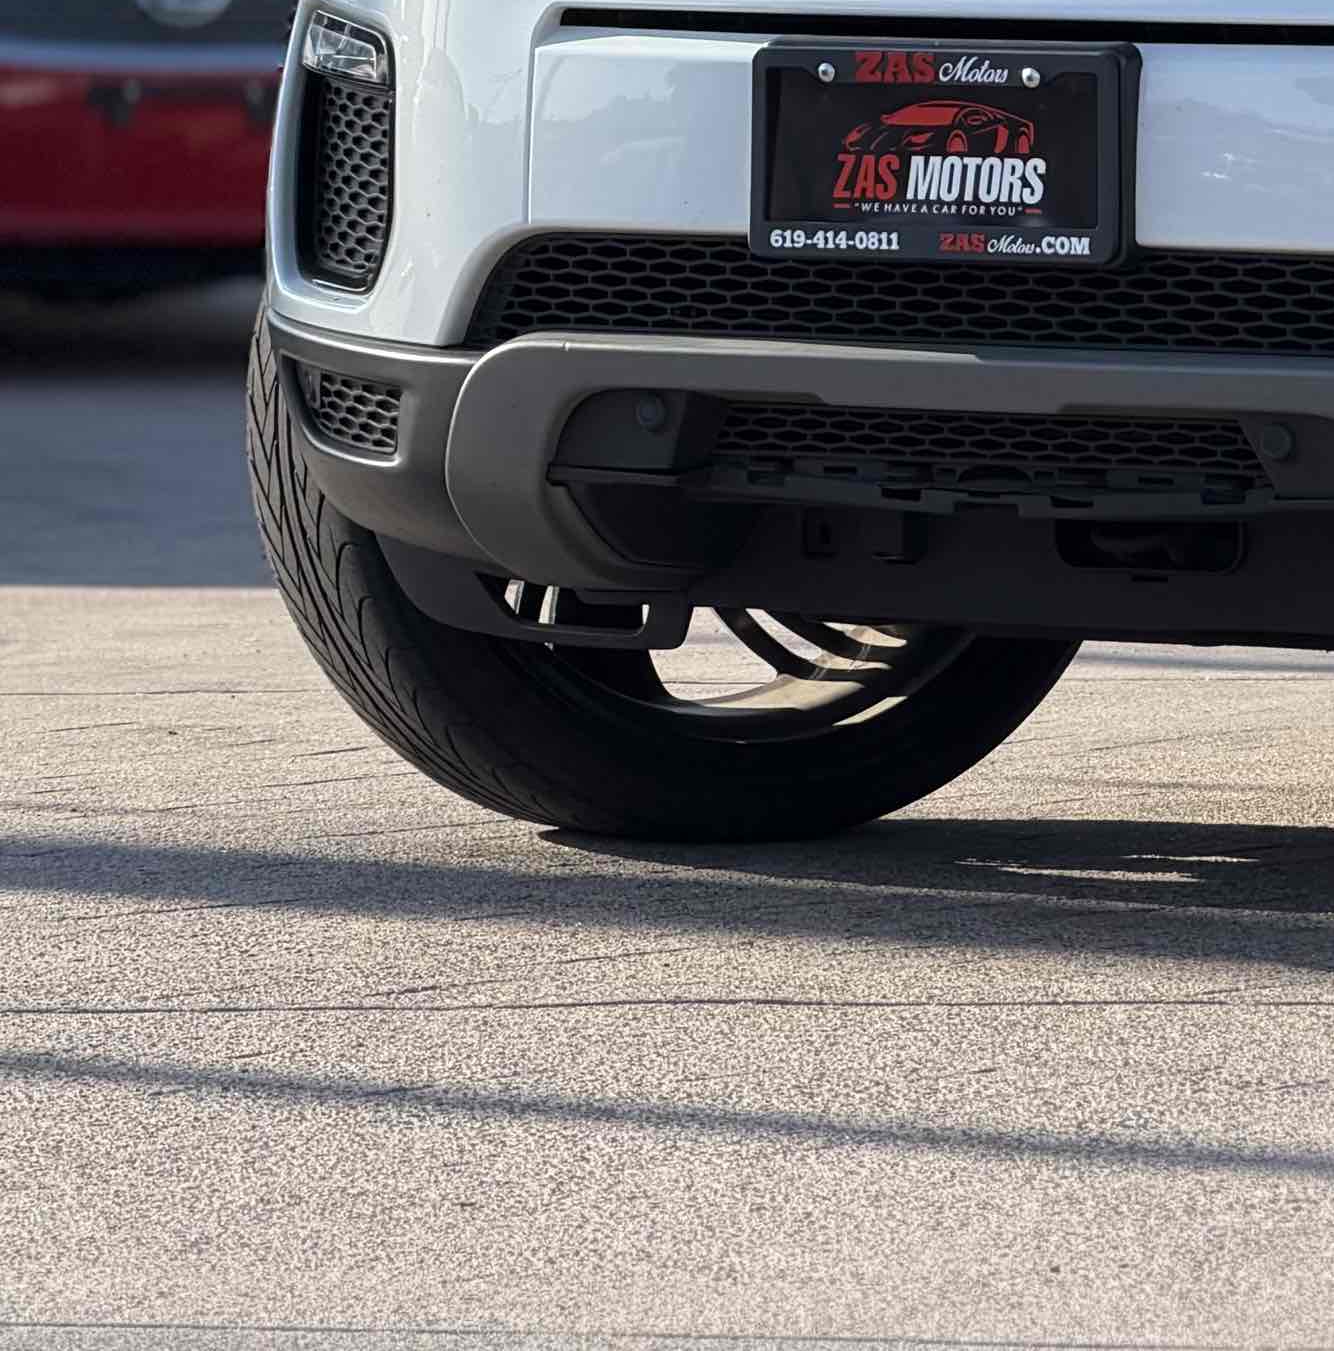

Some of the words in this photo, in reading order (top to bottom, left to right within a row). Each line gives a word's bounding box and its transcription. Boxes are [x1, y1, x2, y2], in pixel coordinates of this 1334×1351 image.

[854, 51, 936, 83] ZAS
[938, 56, 1009, 83] Motors
[832, 154, 900, 200] ZAS
[906, 155, 1047, 204] MOTORS
[883, 203, 921, 214] HAVE
[921, 205, 929, 214] A
[932, 205, 957, 215] CAR
[961, 206, 985, 216] FOR
[769, 229, 900, 250] 619-414-0811
